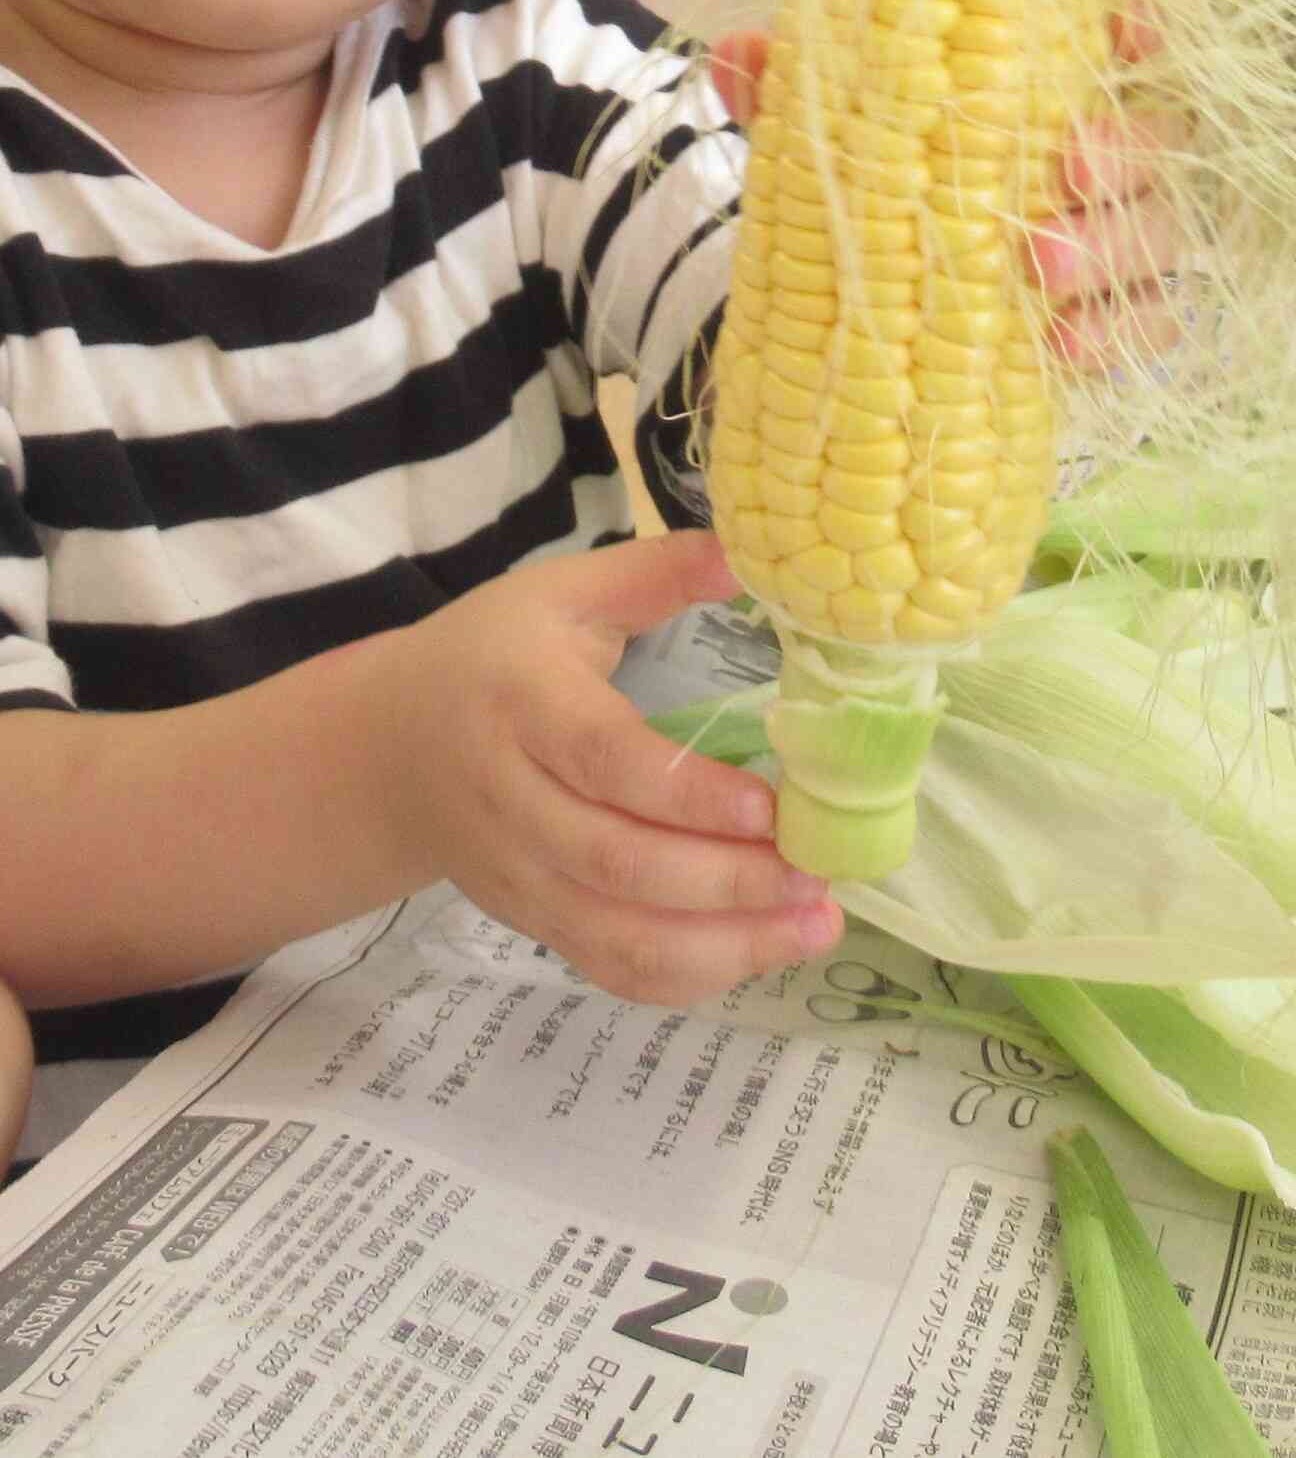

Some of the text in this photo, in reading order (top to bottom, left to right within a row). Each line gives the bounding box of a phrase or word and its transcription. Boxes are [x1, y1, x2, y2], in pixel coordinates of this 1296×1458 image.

[44, 1277, 154, 1390] ニュースパーク
